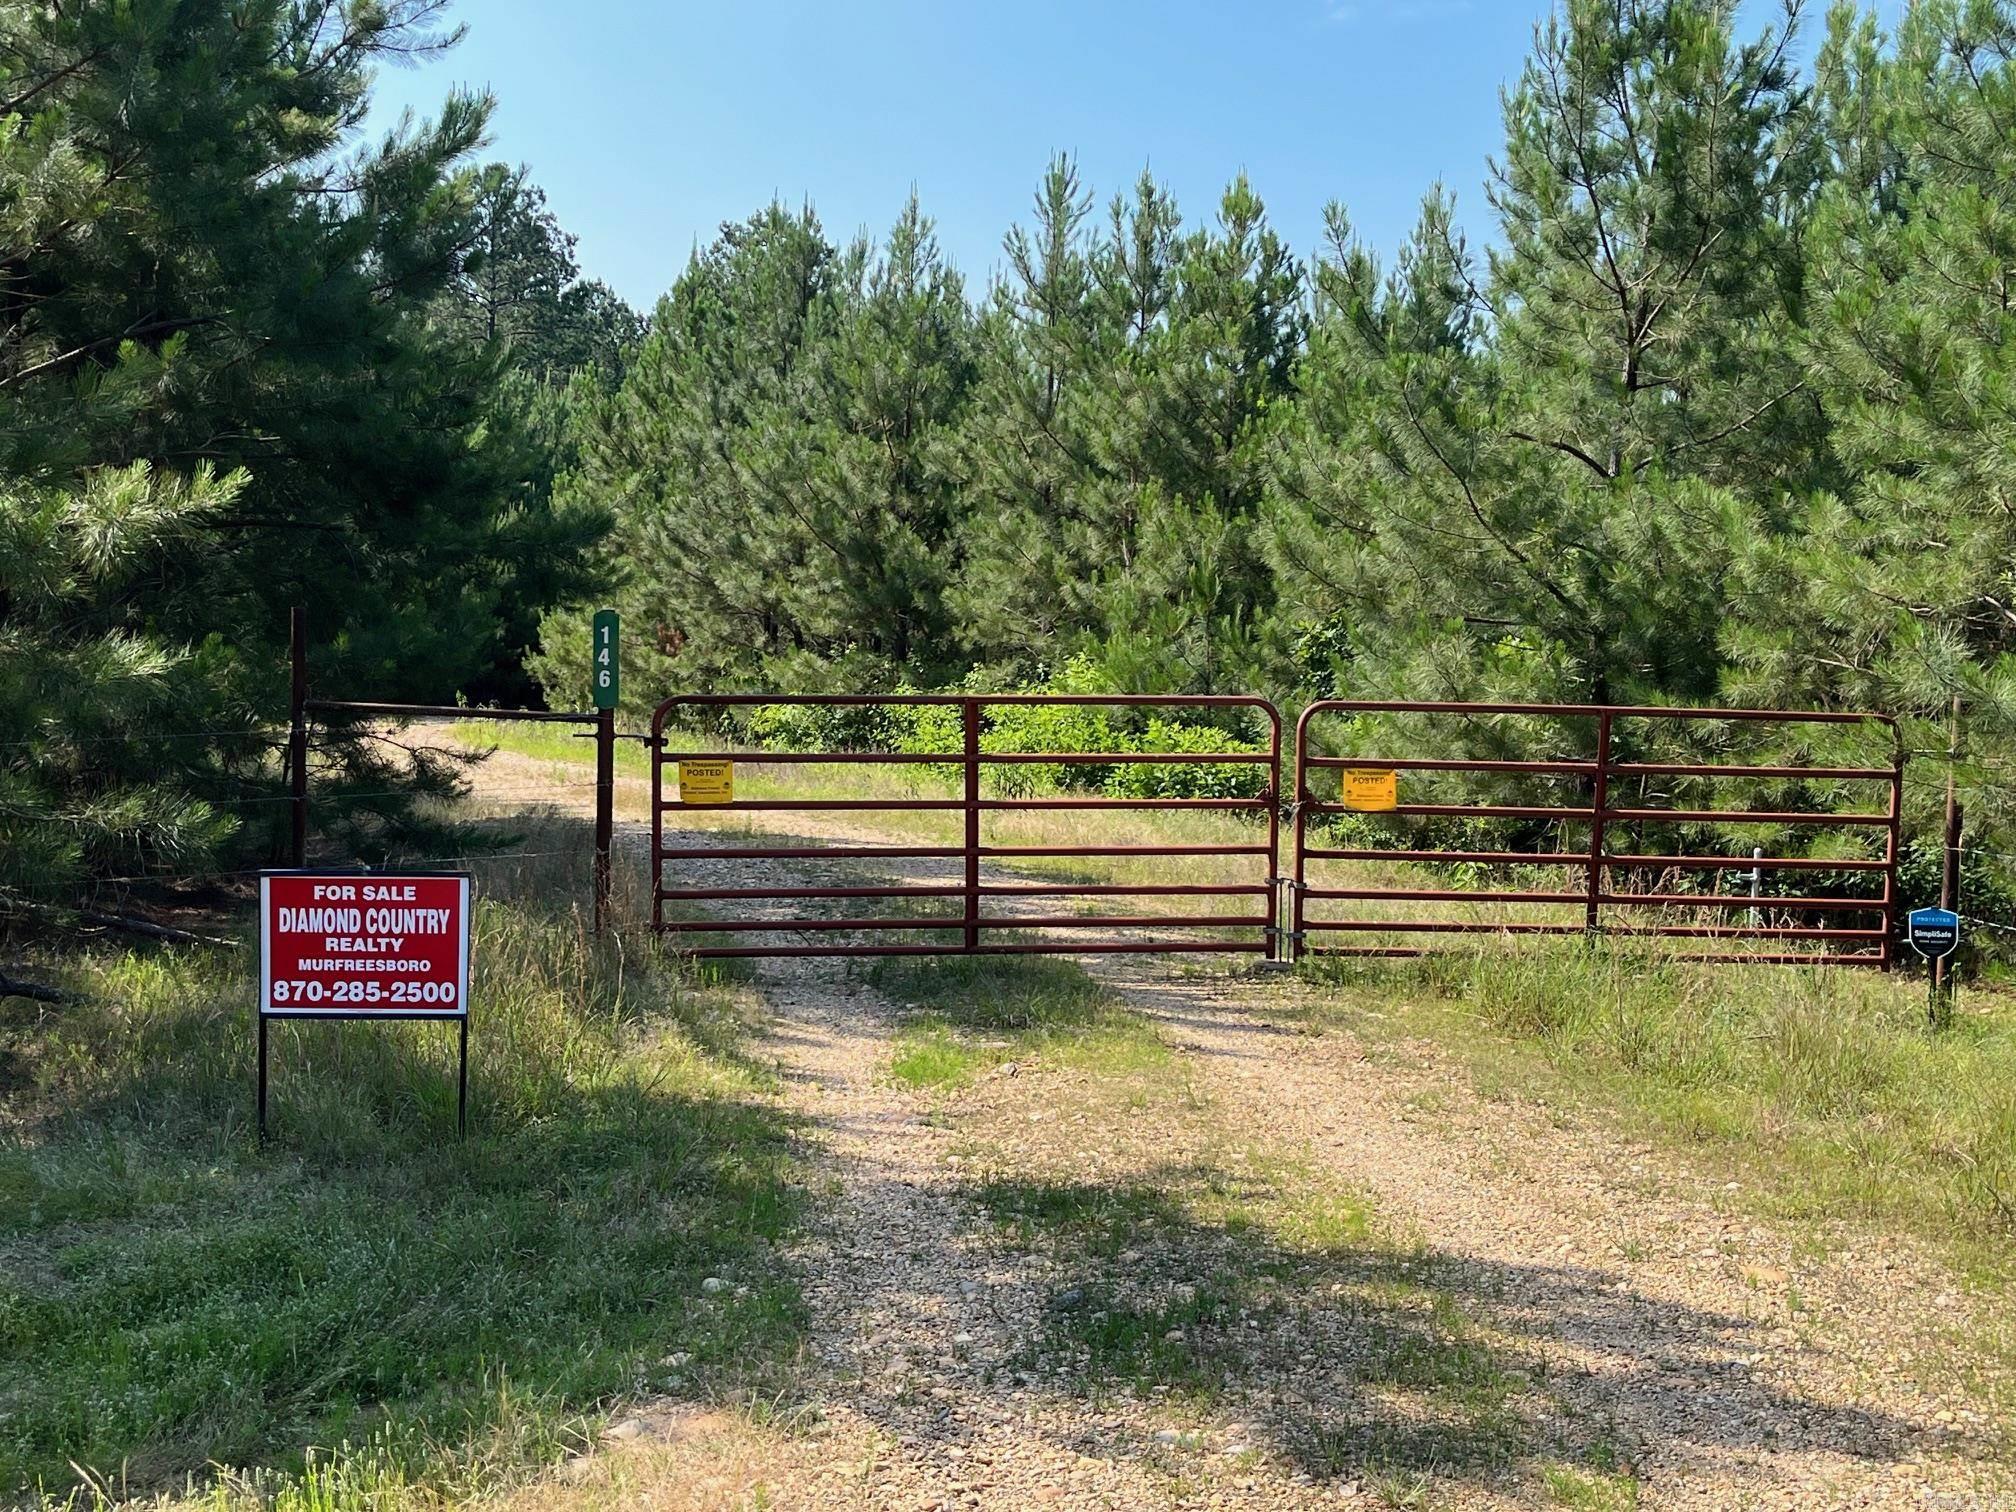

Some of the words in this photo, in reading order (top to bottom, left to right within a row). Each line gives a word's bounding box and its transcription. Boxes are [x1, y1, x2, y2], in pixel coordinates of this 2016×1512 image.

[598, 625, 611, 688] 146
[686, 768, 724, 777] POSTED!
[313, 885, 356, 901] FOR
[362, 885, 417, 901] SALE
[278, 907, 361, 934] DIAMOND
[365, 907, 451, 935] COUNTRY
[1914, 929, 1952, 939] SimpliSafe
[325, 937, 405, 952] REALTY
[298, 958, 431, 972] MURFREESBORO
[273, 980, 456, 1003] 870-285-2500
